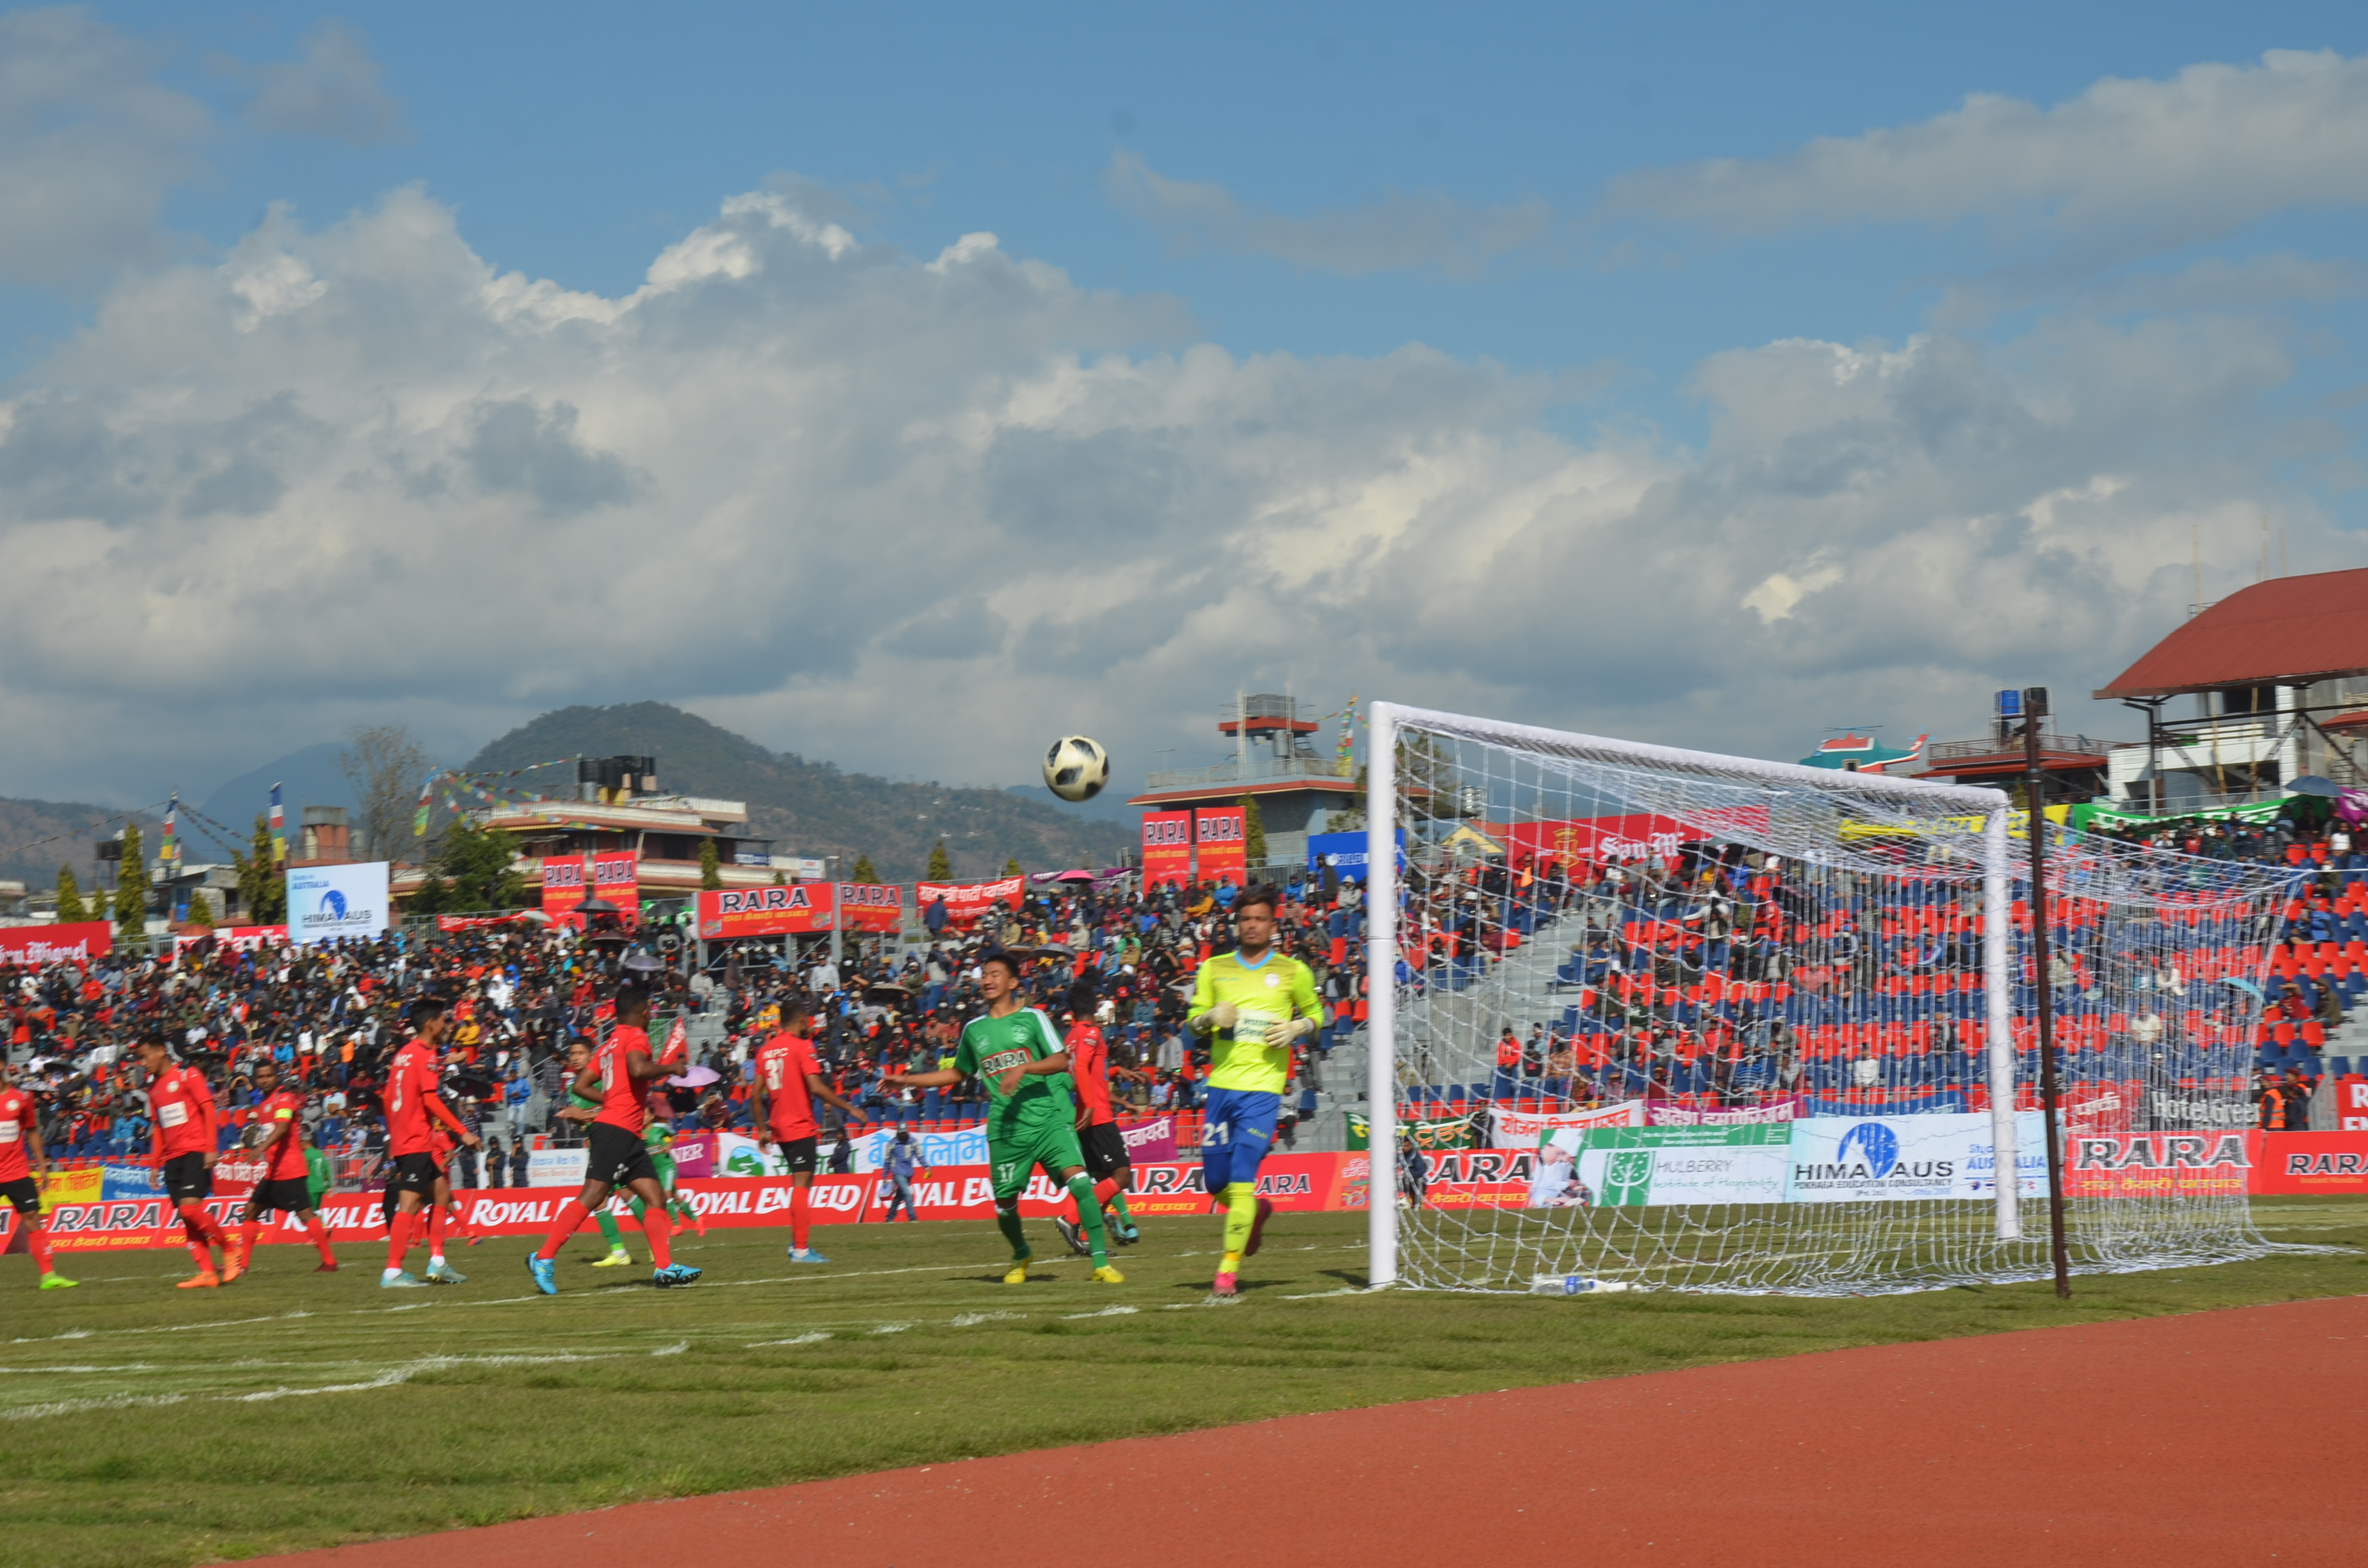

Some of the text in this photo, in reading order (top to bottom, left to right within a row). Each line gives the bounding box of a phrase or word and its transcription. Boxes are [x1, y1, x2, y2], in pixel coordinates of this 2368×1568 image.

[1143, 820, 1189, 846] RARA
[1197, 816, 1244, 842] RARA
[543, 864, 582, 888] RARA
[595, 860, 636, 885] RARA
[718, 886, 812, 914] RARA
[841, 885, 900, 908] RARA
[981, 1049, 1030, 1075] RARA
[1202, 1122, 1229, 1147] 21
[1966, 1156, 2047, 1170] AUSALIA
[2073, 1134, 2255, 1170] RARA
[997, 1163, 1016, 1183] 17
[1889, 1161, 1953, 1178] AUS
[468, 1198, 552, 1227] ROYAL
[754, 1185, 862, 1214] ENIELD
[47, 1202, 161, 1234] RARA
